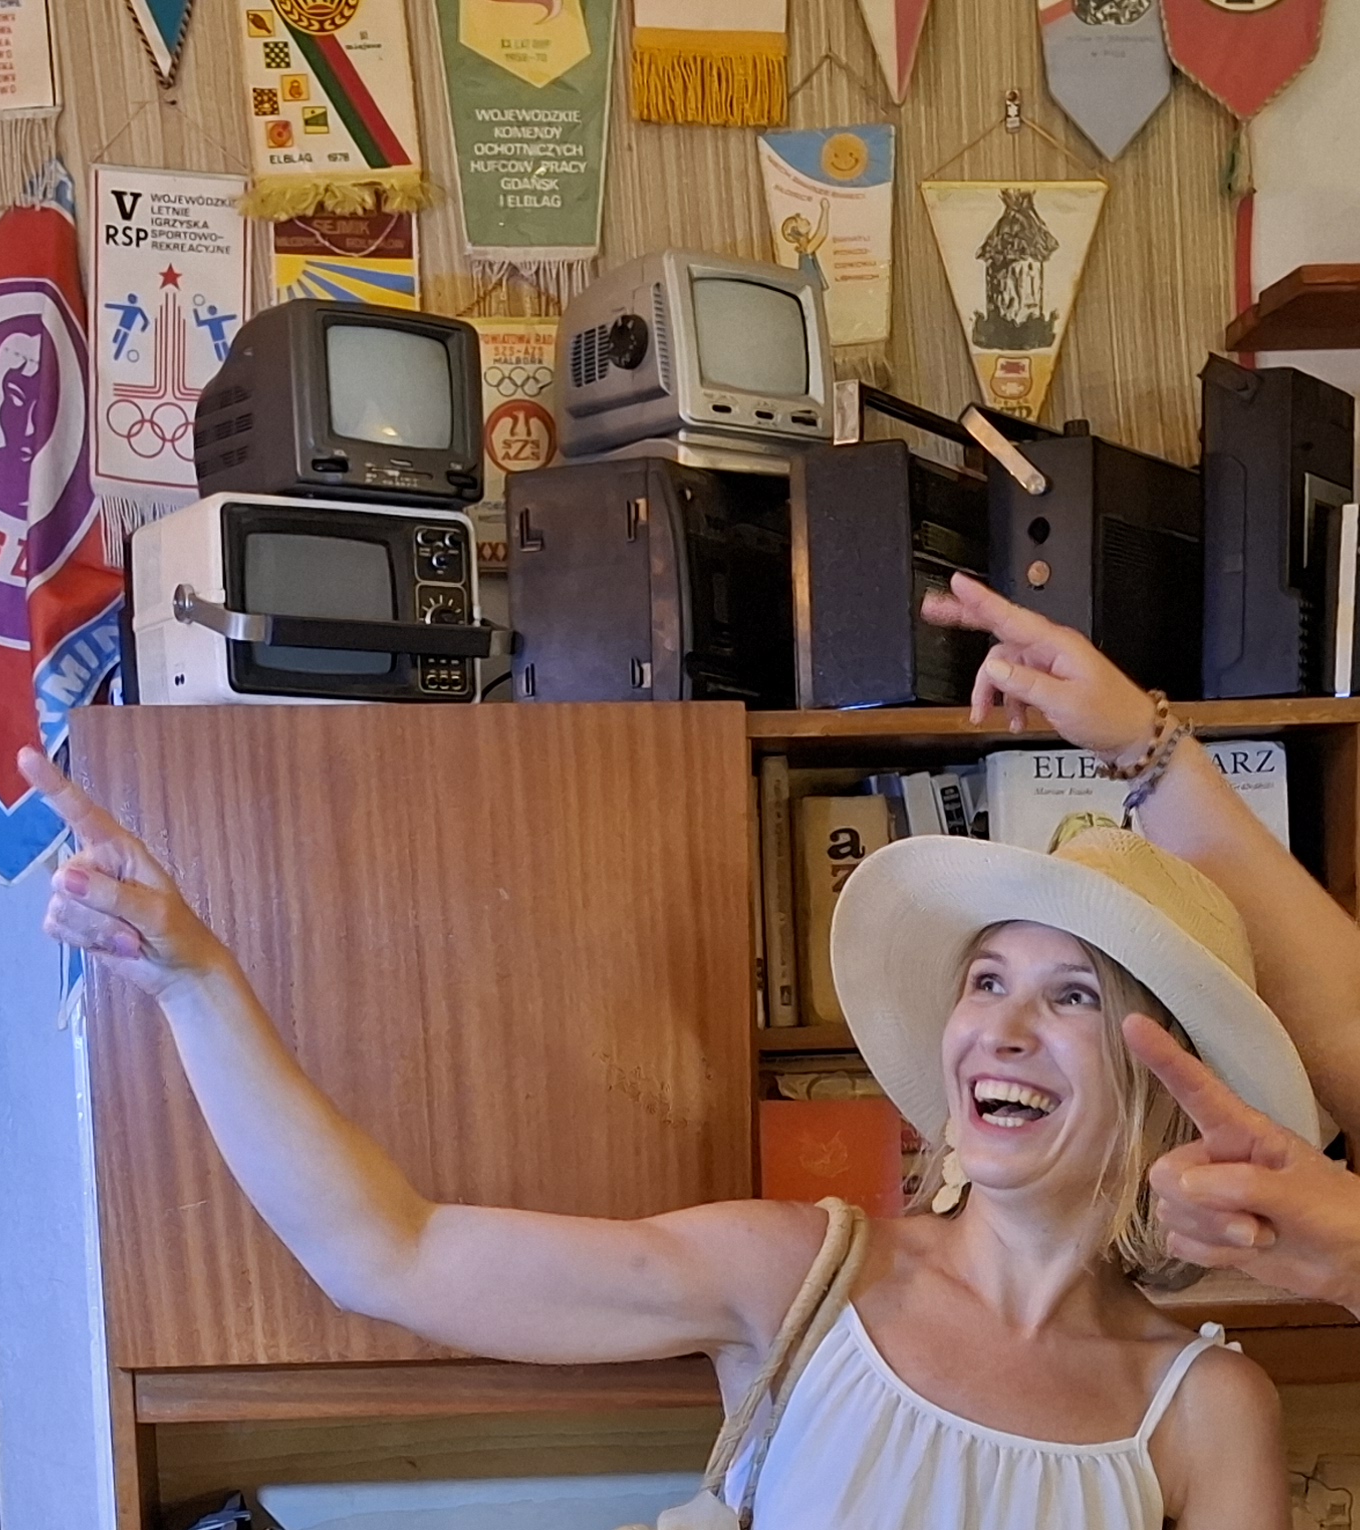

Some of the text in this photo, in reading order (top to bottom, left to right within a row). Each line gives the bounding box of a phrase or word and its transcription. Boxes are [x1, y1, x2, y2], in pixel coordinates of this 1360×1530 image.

[494, 125, 563, 140] KOMENDY
[473, 142, 584, 158] OCHOTNICZYCH
[540, 160, 588, 174] PRACY
[110, 189, 143, 222] V
[150, 205, 191, 218] LETNIE
[150, 217, 210, 230] IGRZYSKA
[104, 224, 149, 249] RSP
[150, 228, 225, 243] SPORTOWO-
[150, 240, 232, 256] REKREACYJNE
[481, 333, 532, 345] OWIATOWA
